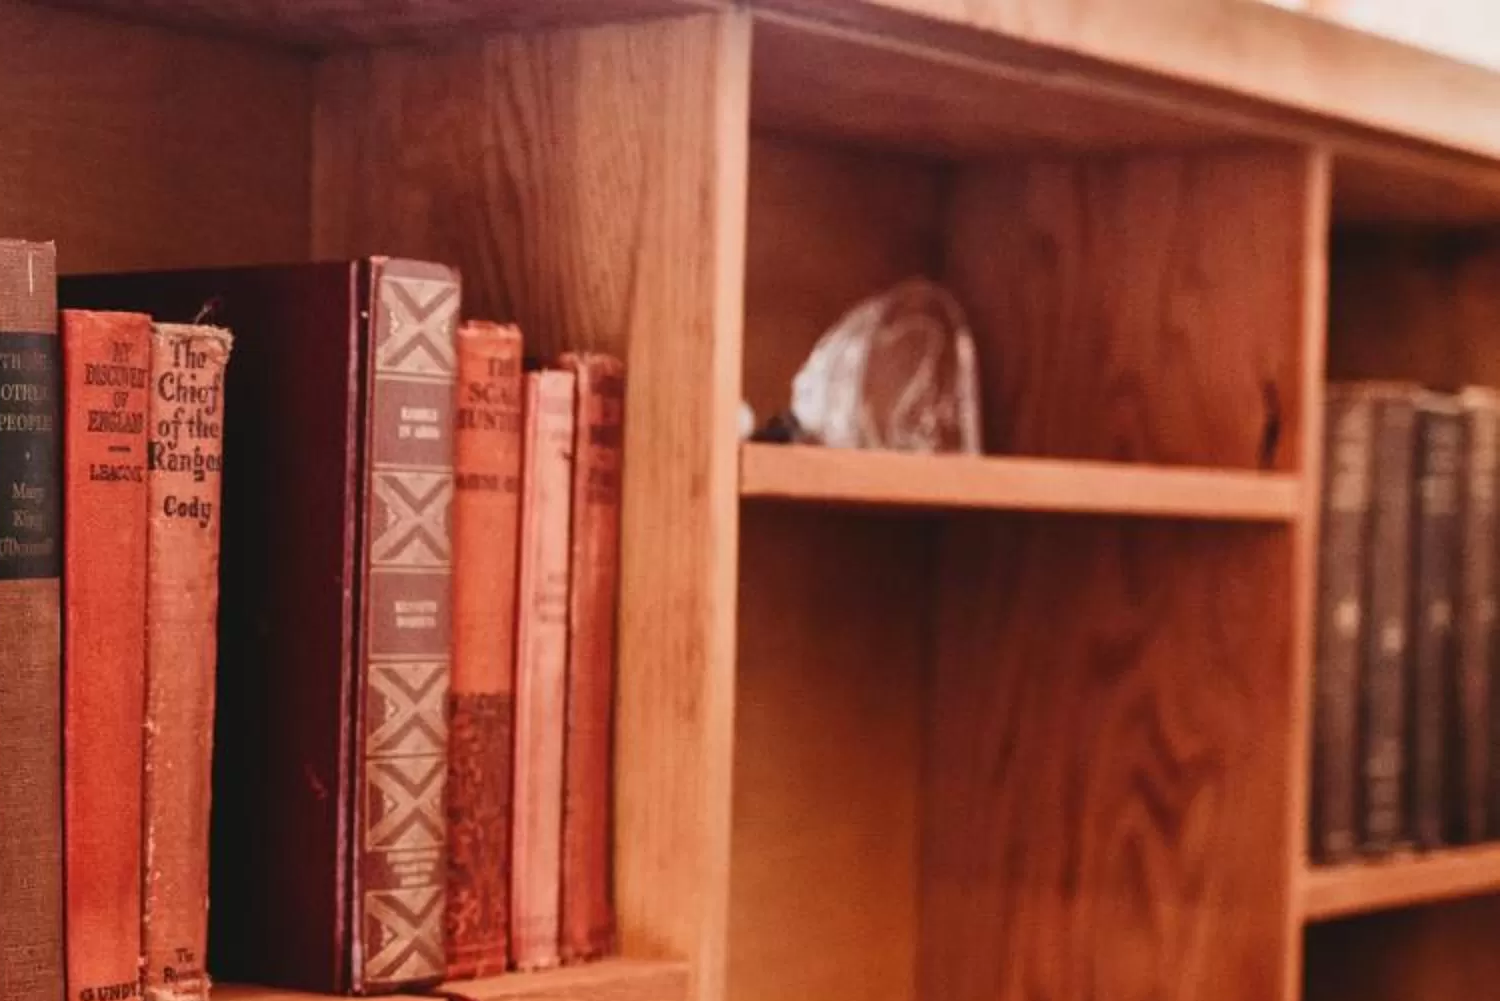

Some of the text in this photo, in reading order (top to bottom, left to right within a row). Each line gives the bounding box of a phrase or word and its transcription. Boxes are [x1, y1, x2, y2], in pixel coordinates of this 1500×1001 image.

[169, 338, 206, 368] The
[158, 371, 219, 415] Chief
[158, 407, 219, 449] of the
[162, 495, 213, 529] Cody
